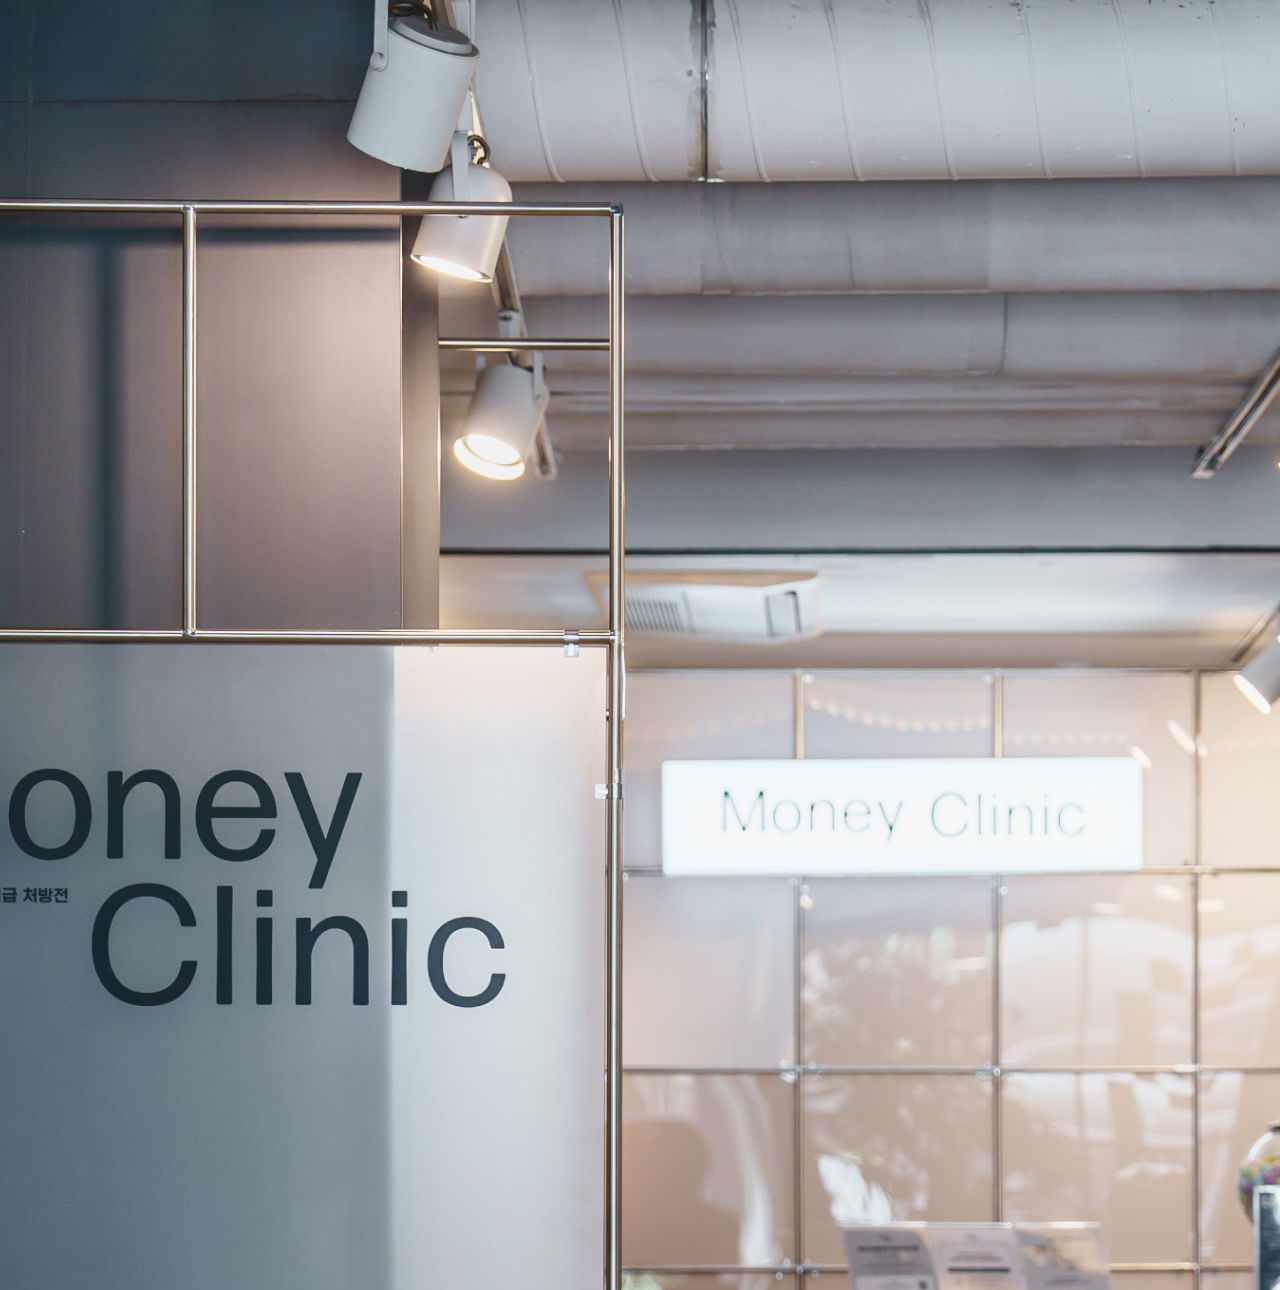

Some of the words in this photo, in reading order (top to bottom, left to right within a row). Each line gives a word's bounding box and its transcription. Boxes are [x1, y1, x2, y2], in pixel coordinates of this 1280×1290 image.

[722, 790, 903, 842] Money
[931, 792, 1084, 837] Clinic
[22, 887, 69, 904] 처방전
[91, 883, 508, 1009] Clinic
